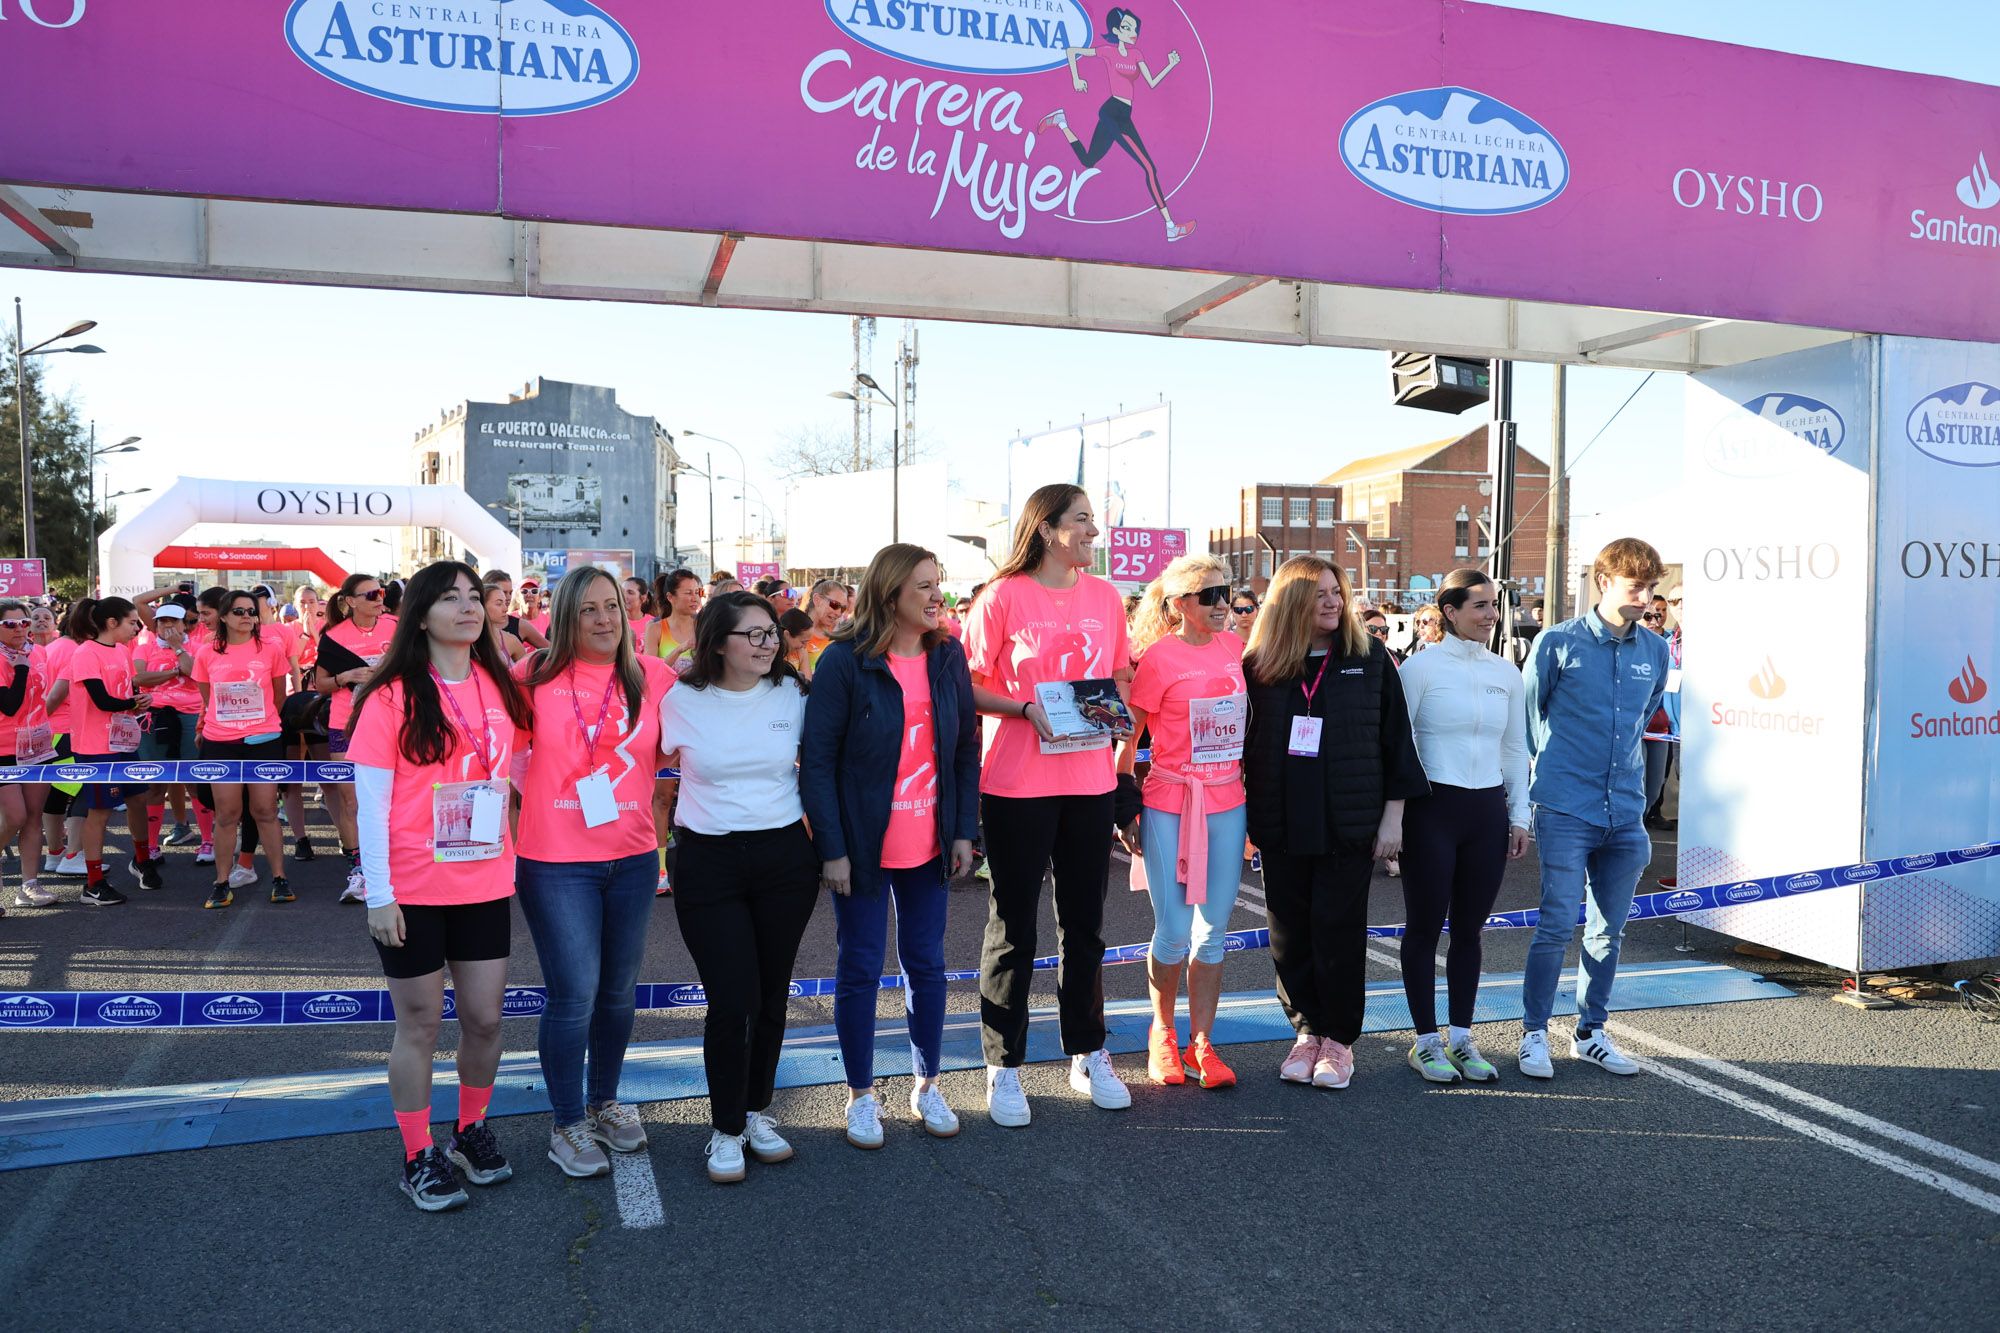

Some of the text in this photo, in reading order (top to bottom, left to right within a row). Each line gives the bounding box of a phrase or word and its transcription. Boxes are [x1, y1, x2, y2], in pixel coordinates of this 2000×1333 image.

[371, 1, 602, 40] CENTRAL LECHERA
[846, 0, 1071, 50] ASTURIANA
[314, 1, 613, 85] ASTURIANA
[800, 49, 1023, 134] Carrera
[1395, 124, 1545, 153] CENTRAL LECHERA
[1358, 123, 1552, 190] ASTURIANA
[855, 126, 1102, 239] de la Mujer
[1672, 168, 1823, 222] OYSHO
[1910, 209, 2000, 248] Santan
[1937, 410, 1980, 421] CENTRAL
[480, 421, 631, 440] EL PUERTO VALENCIA.com
[493, 438, 564, 450] Restaurante
[257, 488, 392, 516] OYSHO
[1113, 530, 1152, 548] SUB
[193, 551, 268, 561] Sports Santander
[533, 552, 567, 567] Mar
[1901, 540, 2000, 579] OYSH
[1703, 542, 1840, 582] OYSHO
[742, 565, 762, 575] SUB
[1027, 620, 1057, 630] OYSHO
[554, 688, 591, 699] OYSHO
[231, 697, 249, 706] 016
[1712, 702, 1825, 735] Santander
[120, 730, 133, 738] 016
[1215, 724, 1237, 737] 016
[193, 766, 226, 774] ASTURIANA
[257, 766, 289, 774] ASTURIANA
[554, 799, 583, 810] CARRE
[445, 849, 475, 858] OYSHO
[1847, 867, 1878, 878] ASTURIANA
[1789, 878, 1819, 889] ASTURIANA
[1729, 888, 1761, 899] ASTURIANA
[1667, 898, 1701, 909] ASTURIANA
[102, 1006, 157, 1017] ASTURIANA
[207, 1005, 259, 1016] ASTURIANA
[307, 1004, 357, 1014] ASTURIANA
